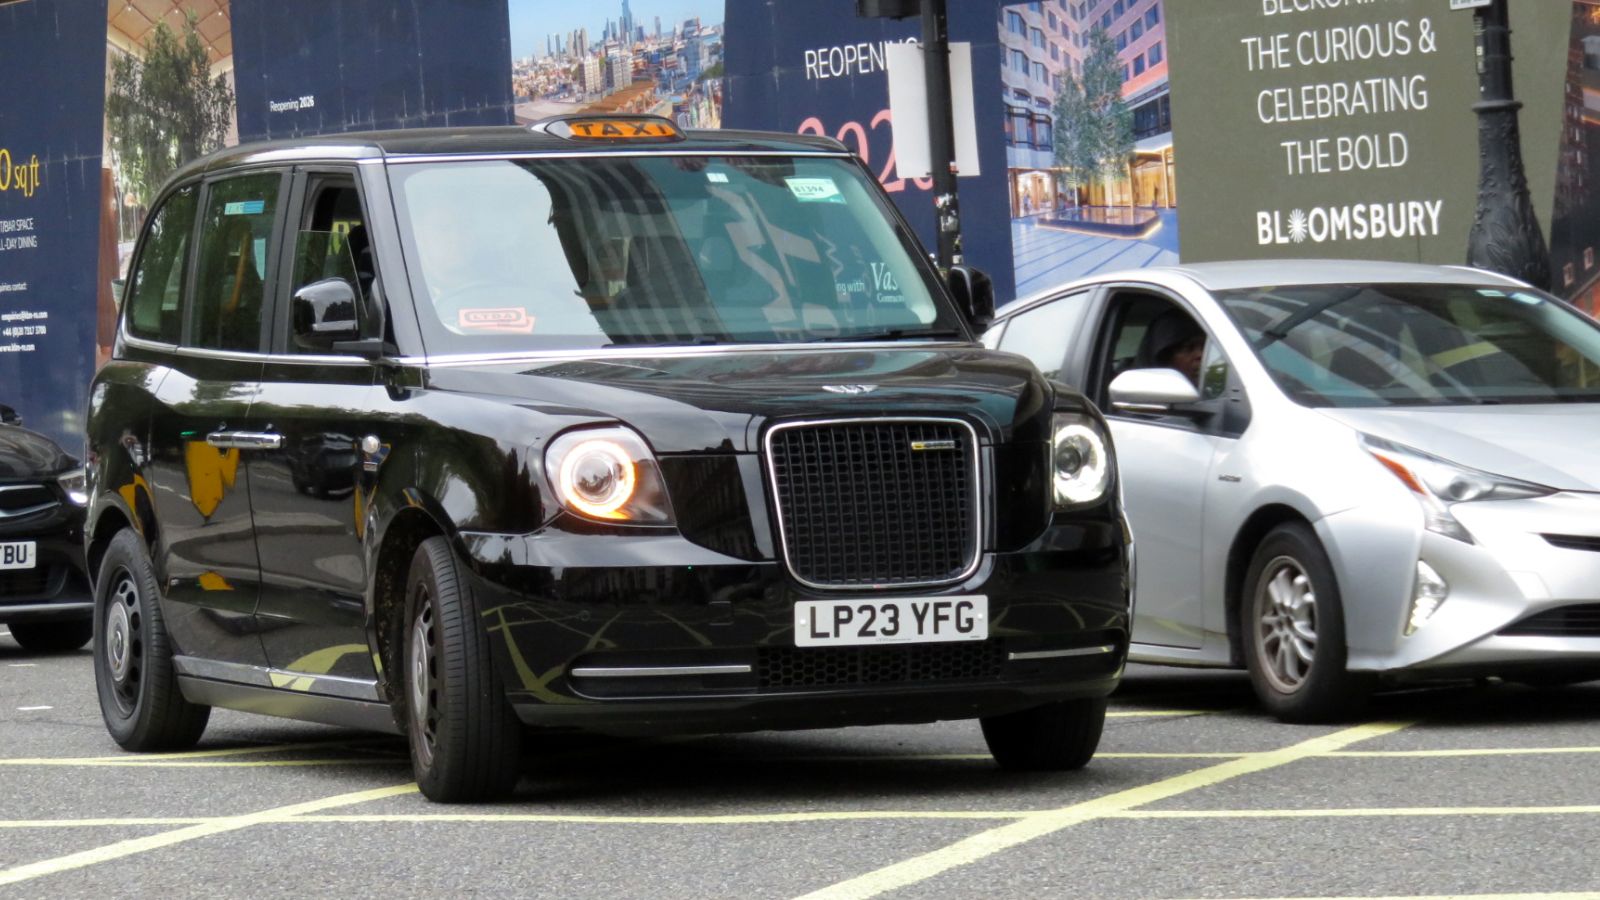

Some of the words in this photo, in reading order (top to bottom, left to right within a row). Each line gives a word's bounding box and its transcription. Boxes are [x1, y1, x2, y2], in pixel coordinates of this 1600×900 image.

[804, 37, 918, 80] REOPENI
[1241, 33, 1291, 71] THE
[1297, 19, 1411, 65] CURIOUS
[1419, 17, 1437, 53] &
[270, 98, 299, 113] Reopening
[299, 95, 314, 108] 2026
[1257, 75, 1428, 123] CELEBRATING
[576, 122, 667, 136] TAXI
[1280, 138, 1331, 175] THE
[1337, 132, 1408, 170] BOLD
[16, 217, 34, 231] SPACE
[18, 235, 38, 249] DINING
[0, 544, 27, 564] BU
[810, 603, 900, 639] LP23
[911, 600, 974, 635] YFG
